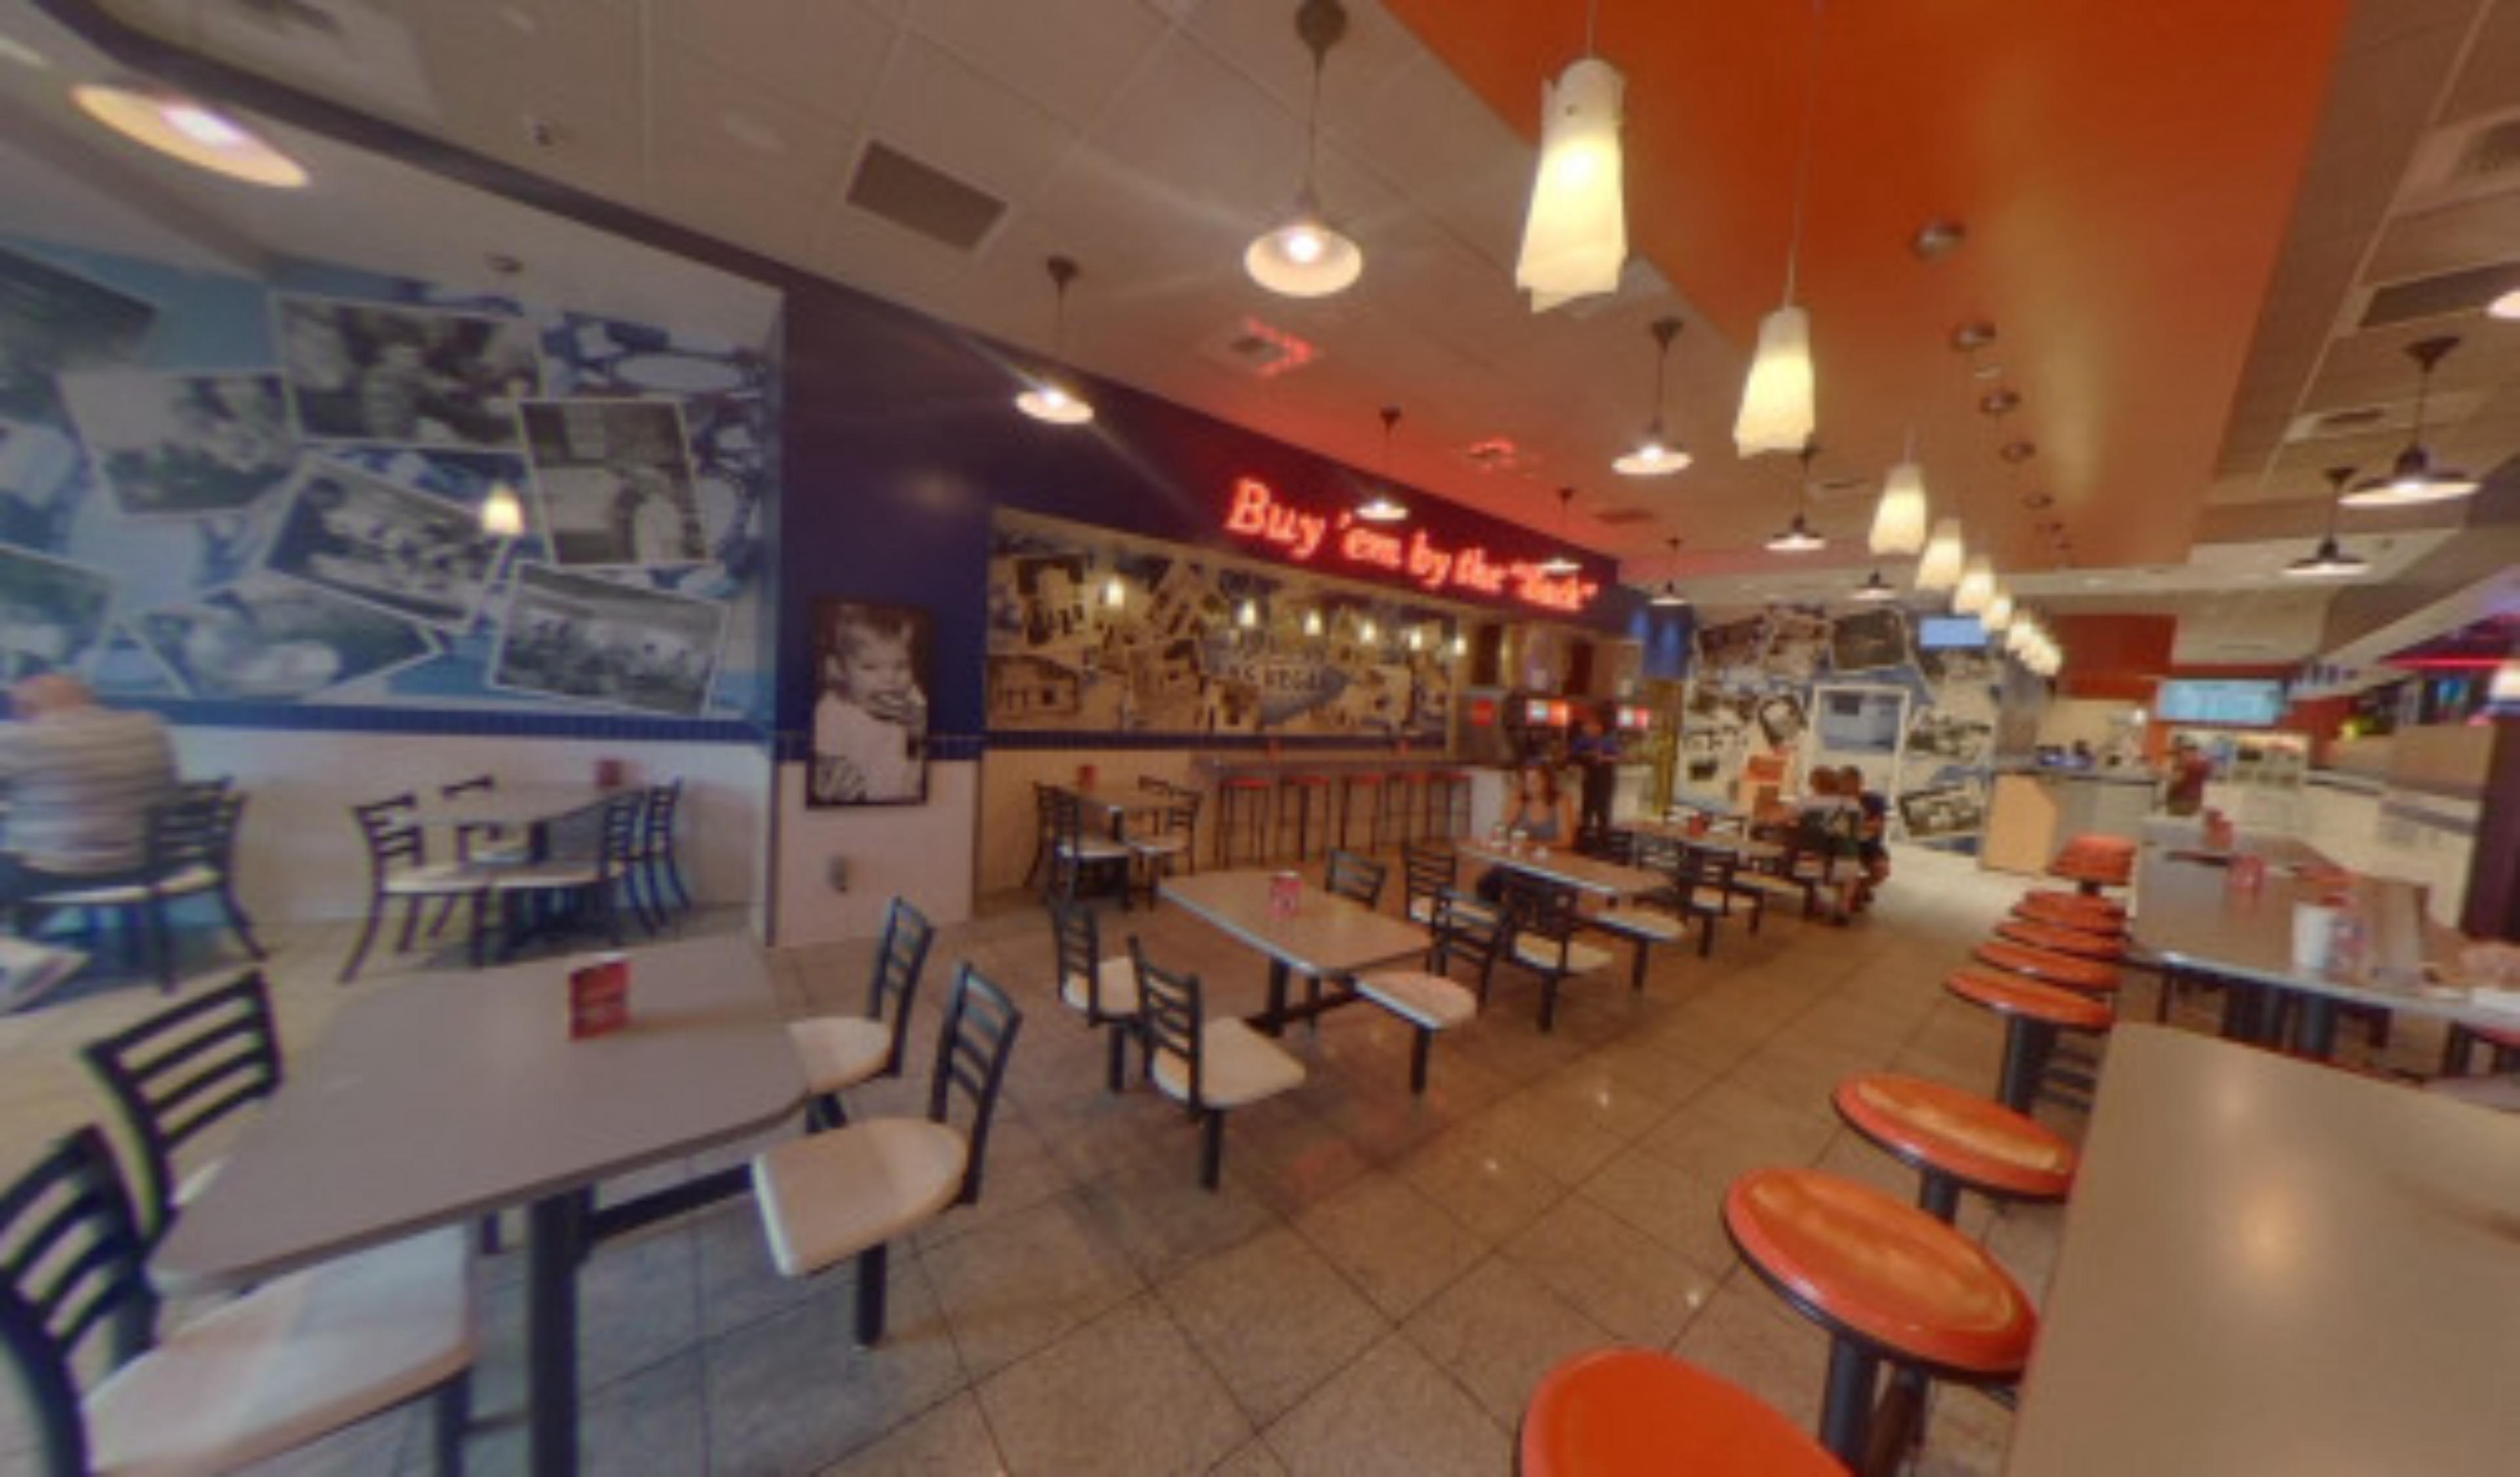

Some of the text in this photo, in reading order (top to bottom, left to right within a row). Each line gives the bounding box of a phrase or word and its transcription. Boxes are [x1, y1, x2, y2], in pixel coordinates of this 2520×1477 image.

[1227, 478, 1326, 558] Buy
[1339, 511, 1402, 567] 'em
[1410, 531, 1453, 587] by
[1456, 547, 1507, 591] the
